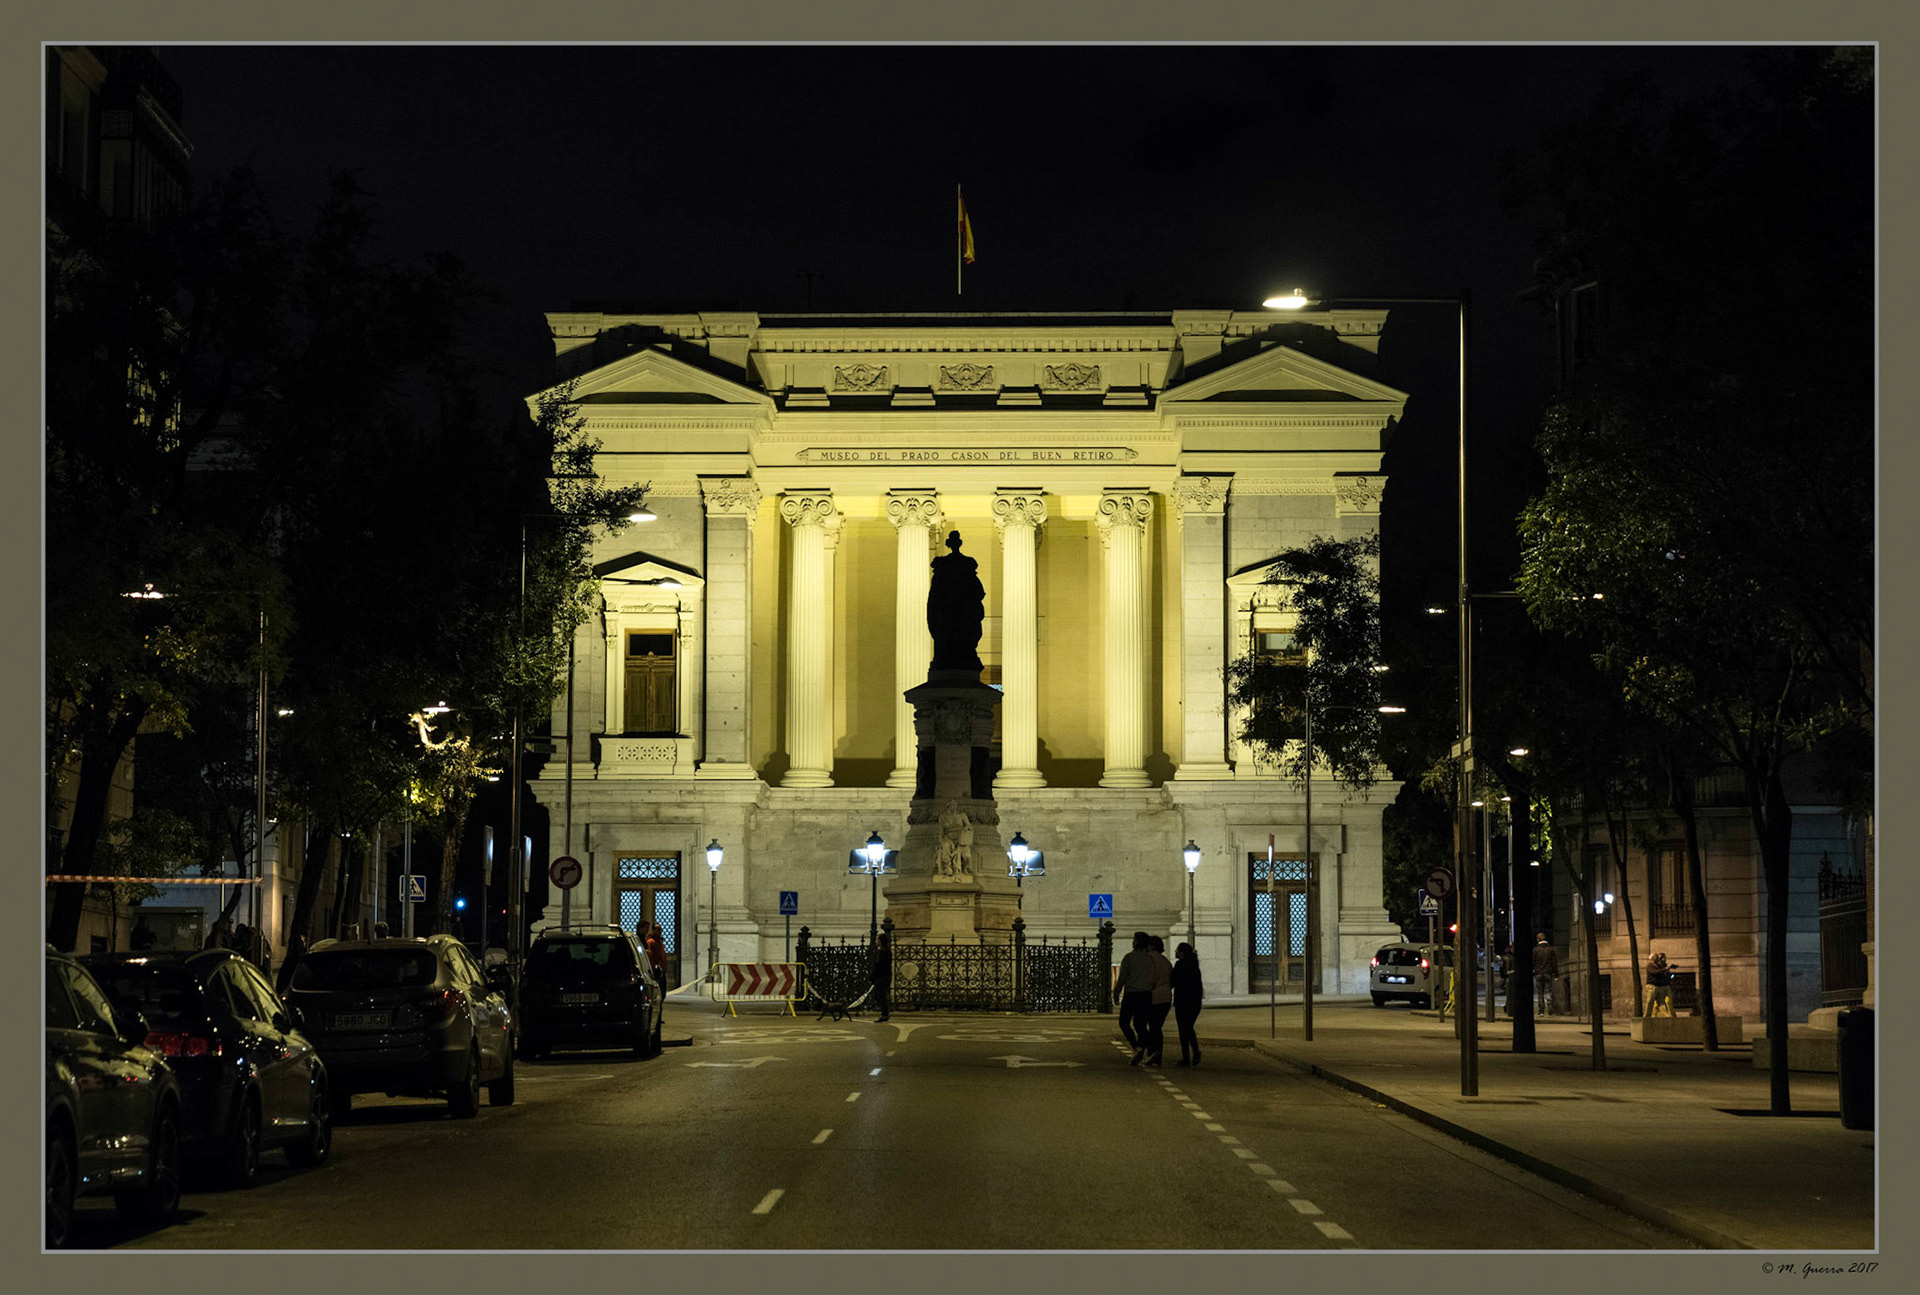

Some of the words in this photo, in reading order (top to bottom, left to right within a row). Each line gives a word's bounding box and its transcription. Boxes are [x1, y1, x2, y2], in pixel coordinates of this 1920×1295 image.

[820, 452, 859, 461] MUSEO
[870, 452, 890, 460] DEL
[901, 452, 939, 460] PRADO
[951, 452, 988, 460] CASON
[999, 452, 1020, 460] DEL
[1032, 452, 1061, 460] BUEN
[1073, 452, 1113, 460] RETIRO
